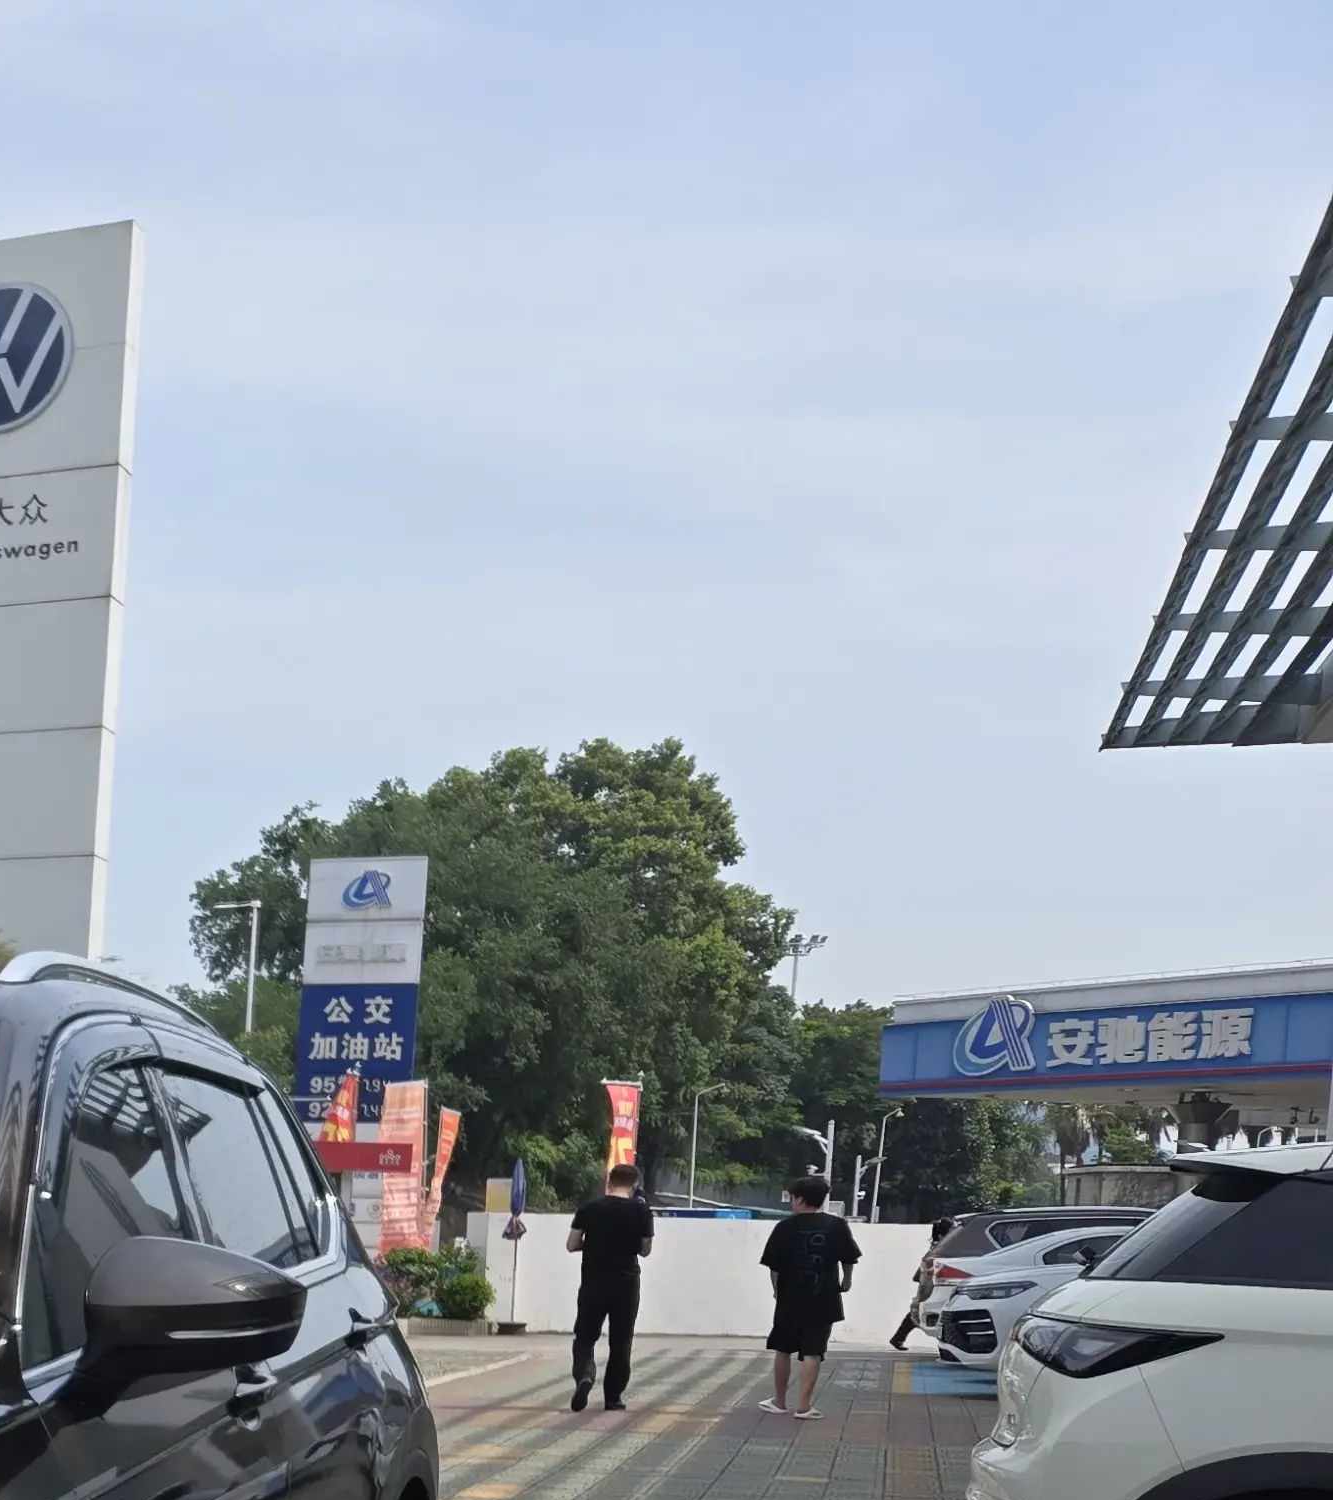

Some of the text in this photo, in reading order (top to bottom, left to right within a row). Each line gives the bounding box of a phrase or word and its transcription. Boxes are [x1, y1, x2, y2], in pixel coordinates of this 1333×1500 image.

[323, 995, 394, 1025] 公交
[308, 1031, 405, 1061] 加油站
[1046, 1007, 1255, 1068] 安驰能源
